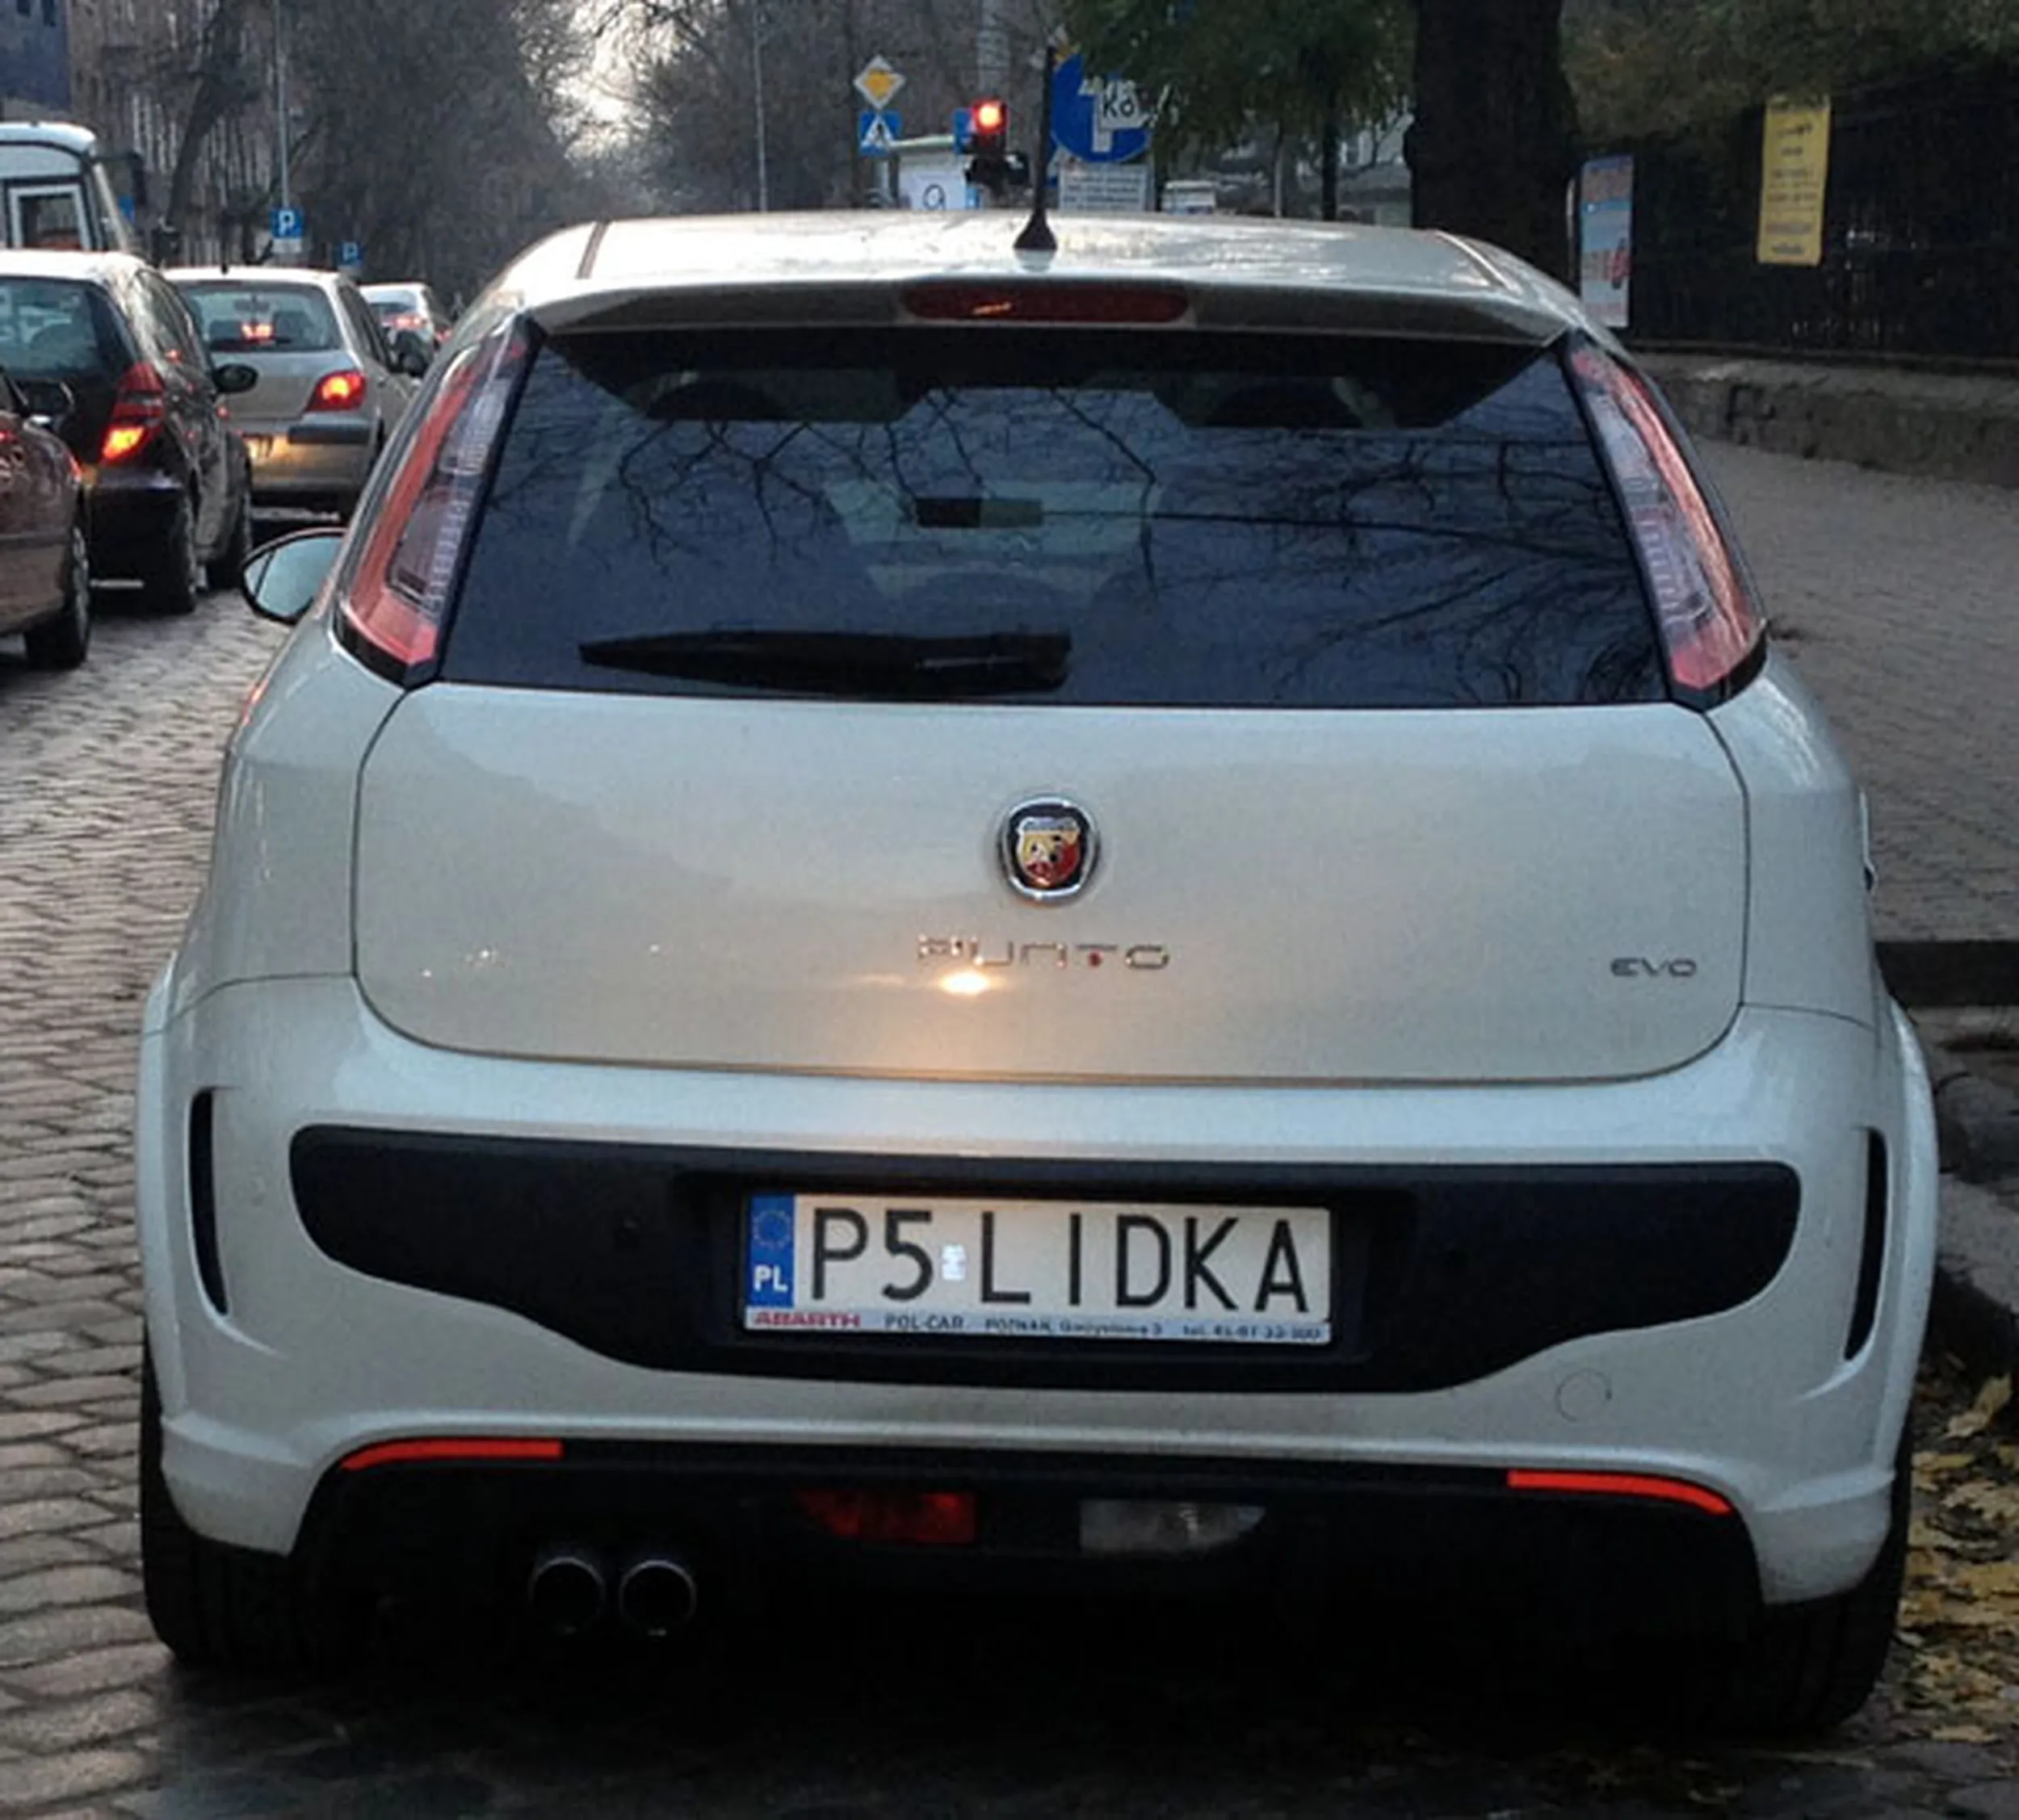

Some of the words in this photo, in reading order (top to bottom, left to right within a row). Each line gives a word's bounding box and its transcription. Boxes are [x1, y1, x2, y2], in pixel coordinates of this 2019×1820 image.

[278, 210, 295, 236] P
[917, 935, 1169, 970] PUNTO
[1610, 957, 1698, 978] EVO
[812, 1207, 933, 1302] P5
[980, 1211, 1310, 1313] LIDKA
[752, 1264, 789, 1292] PL
